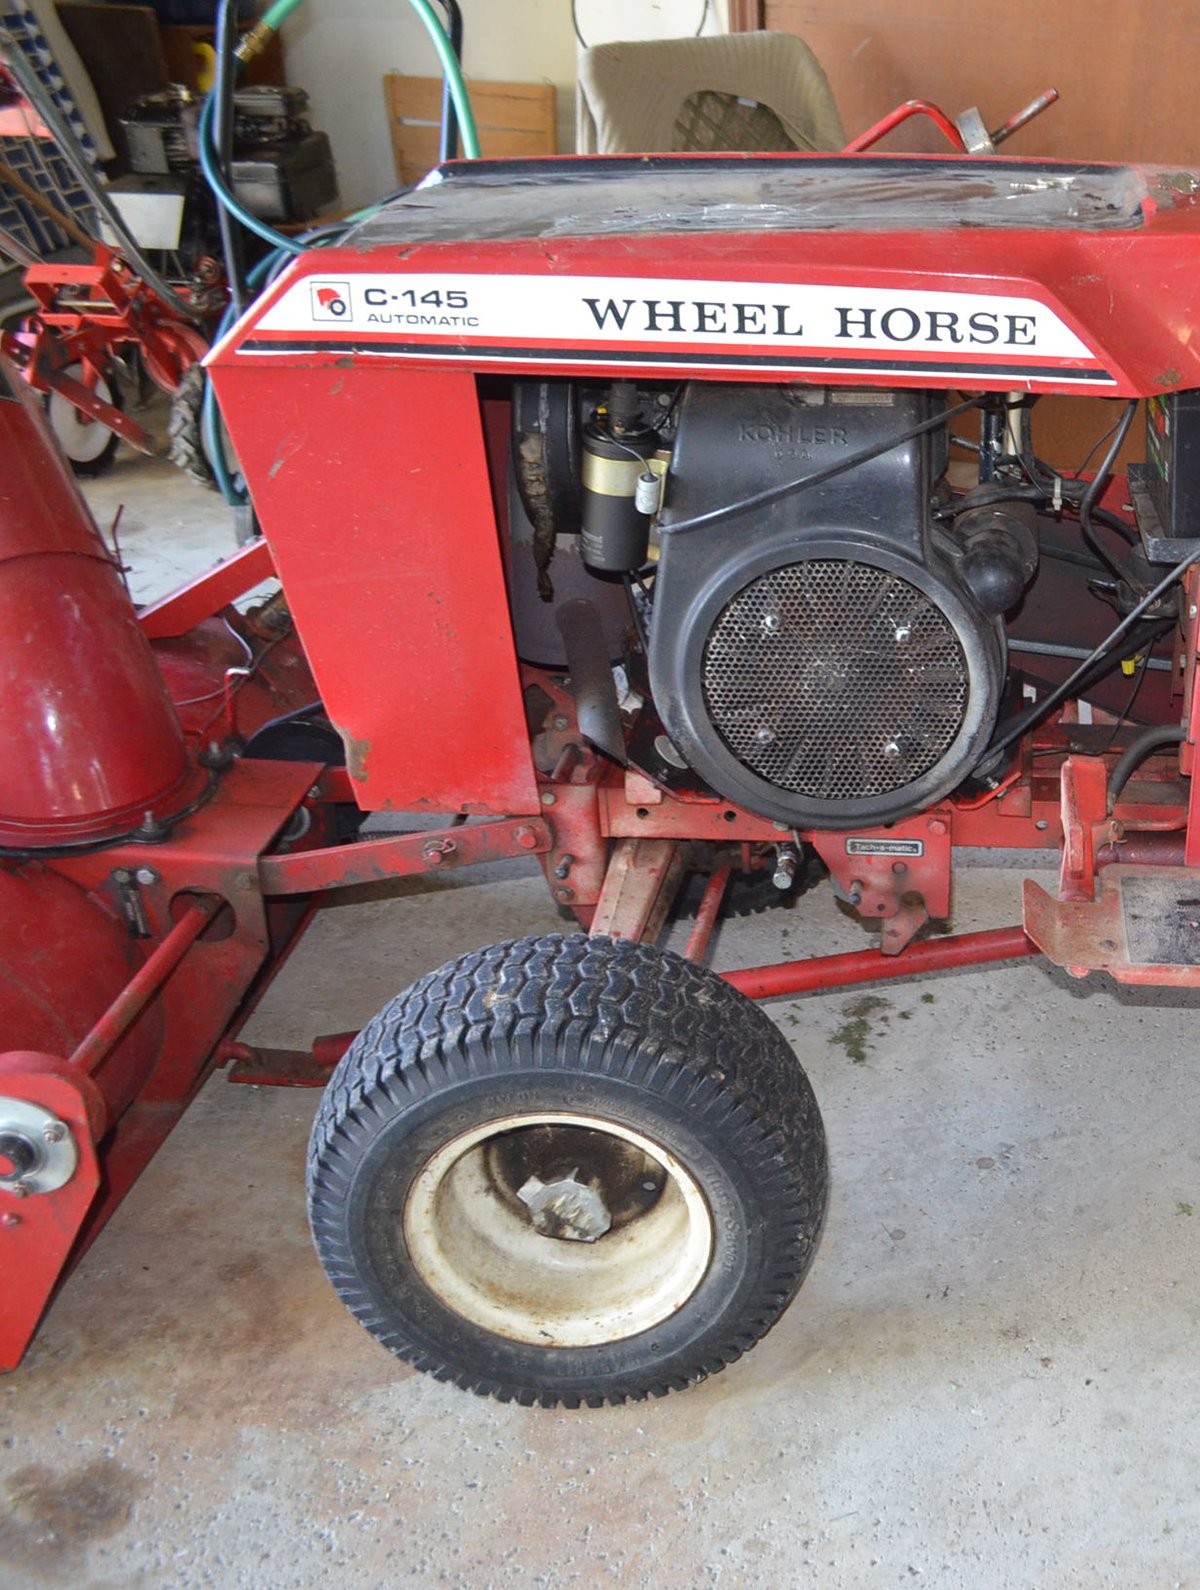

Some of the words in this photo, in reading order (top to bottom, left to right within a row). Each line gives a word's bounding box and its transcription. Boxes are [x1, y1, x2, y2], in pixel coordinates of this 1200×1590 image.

[364, 288, 468, 309] C-145
[367, 313, 479, 327] AUTOMATIC
[582, 298, 803, 336] WHEEL
[834, 307, 1037, 346] HORSE
[738, 424, 849, 446] KOHLER
